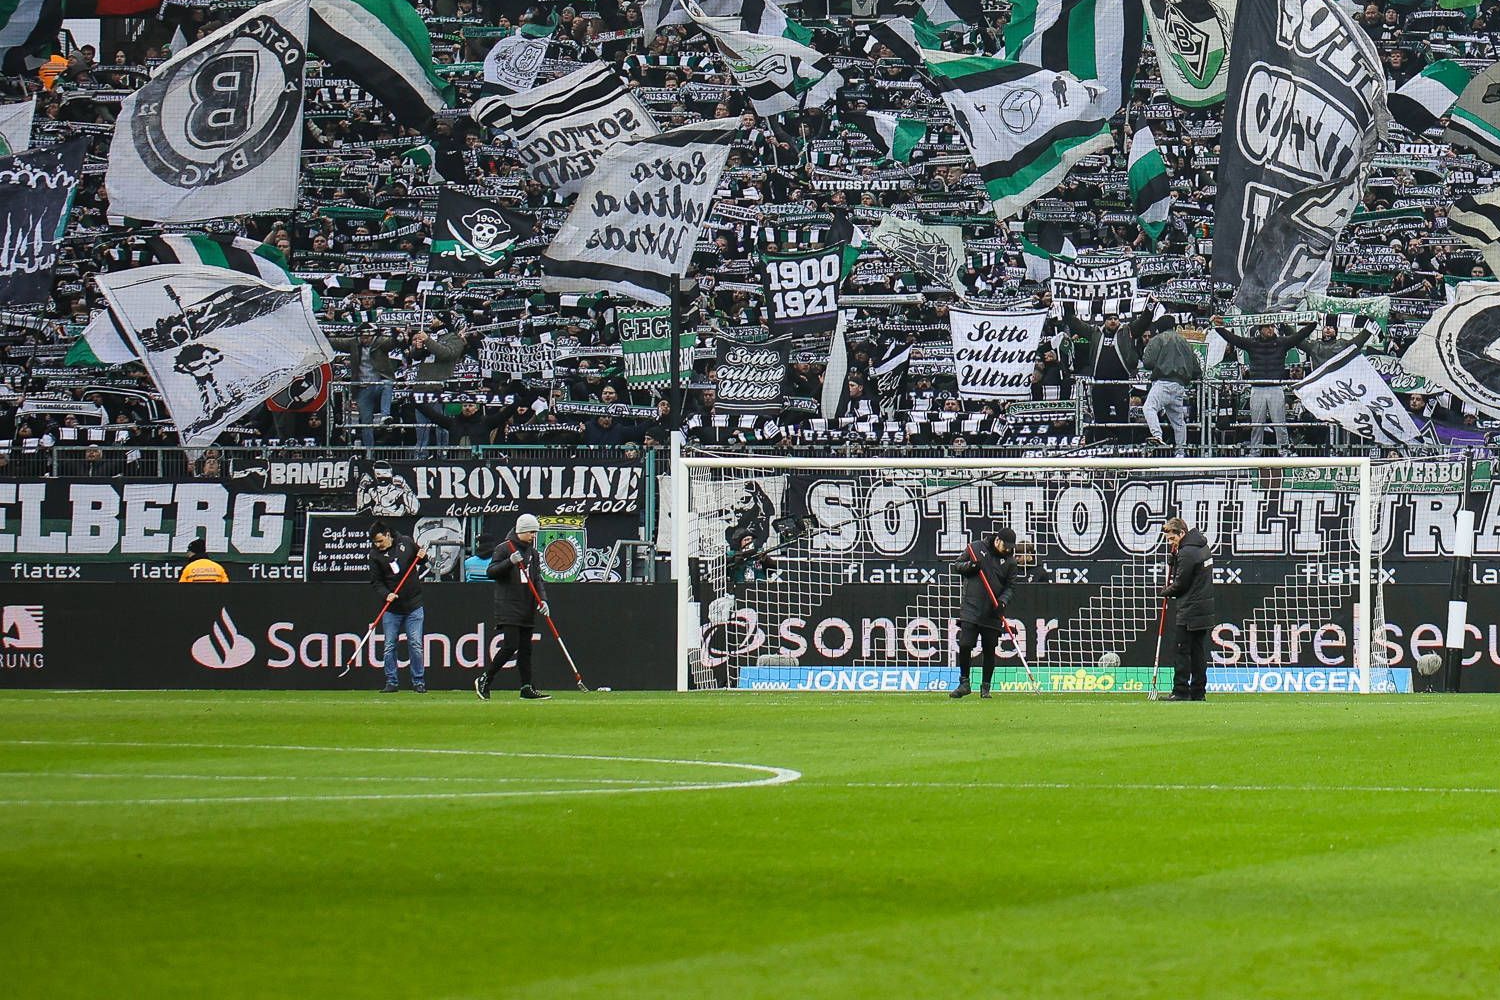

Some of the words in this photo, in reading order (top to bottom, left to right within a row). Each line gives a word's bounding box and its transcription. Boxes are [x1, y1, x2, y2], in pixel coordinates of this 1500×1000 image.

[1400, 143, 1450, 155] KURVE
[812, 180, 900, 190] VITUSSTADT
[476, 214, 502, 224] 1900
[766, 254, 840, 291] 1900
[1053, 261, 1134, 281] KÖLNER
[1053, 282, 1135, 300] KELLER
[773, 285, 838, 319] 1921
[967, 321, 1029, 343] Sotto
[726, 348, 780, 365] Sotto
[956, 345, 1037, 363] cultura
[481, 360, 554, 373] BORUSSIA
[716, 366, 784, 383] cultura
[961, 365, 1032, 388] Ultras
[718, 380, 781, 401] Ultras
[270, 461, 349, 485] BANDA
[319, 478, 346, 489] SUD
[413, 466, 643, 500] FRONTLINE
[555, 502, 586, 515] seit
[590, 499, 637, 514] 2006
[322, 527, 346, 540] Egal
[325, 541, 341, 550] und
[11, 563, 80, 579] flatex
[249, 562, 303, 579] flate
[312, 561, 330, 572] bist
[331, 562, 343, 571] du
[844, 564, 936, 584] flatex
[267, 622, 541, 669] Santnde
[798, 670, 922, 692] JONGEN
